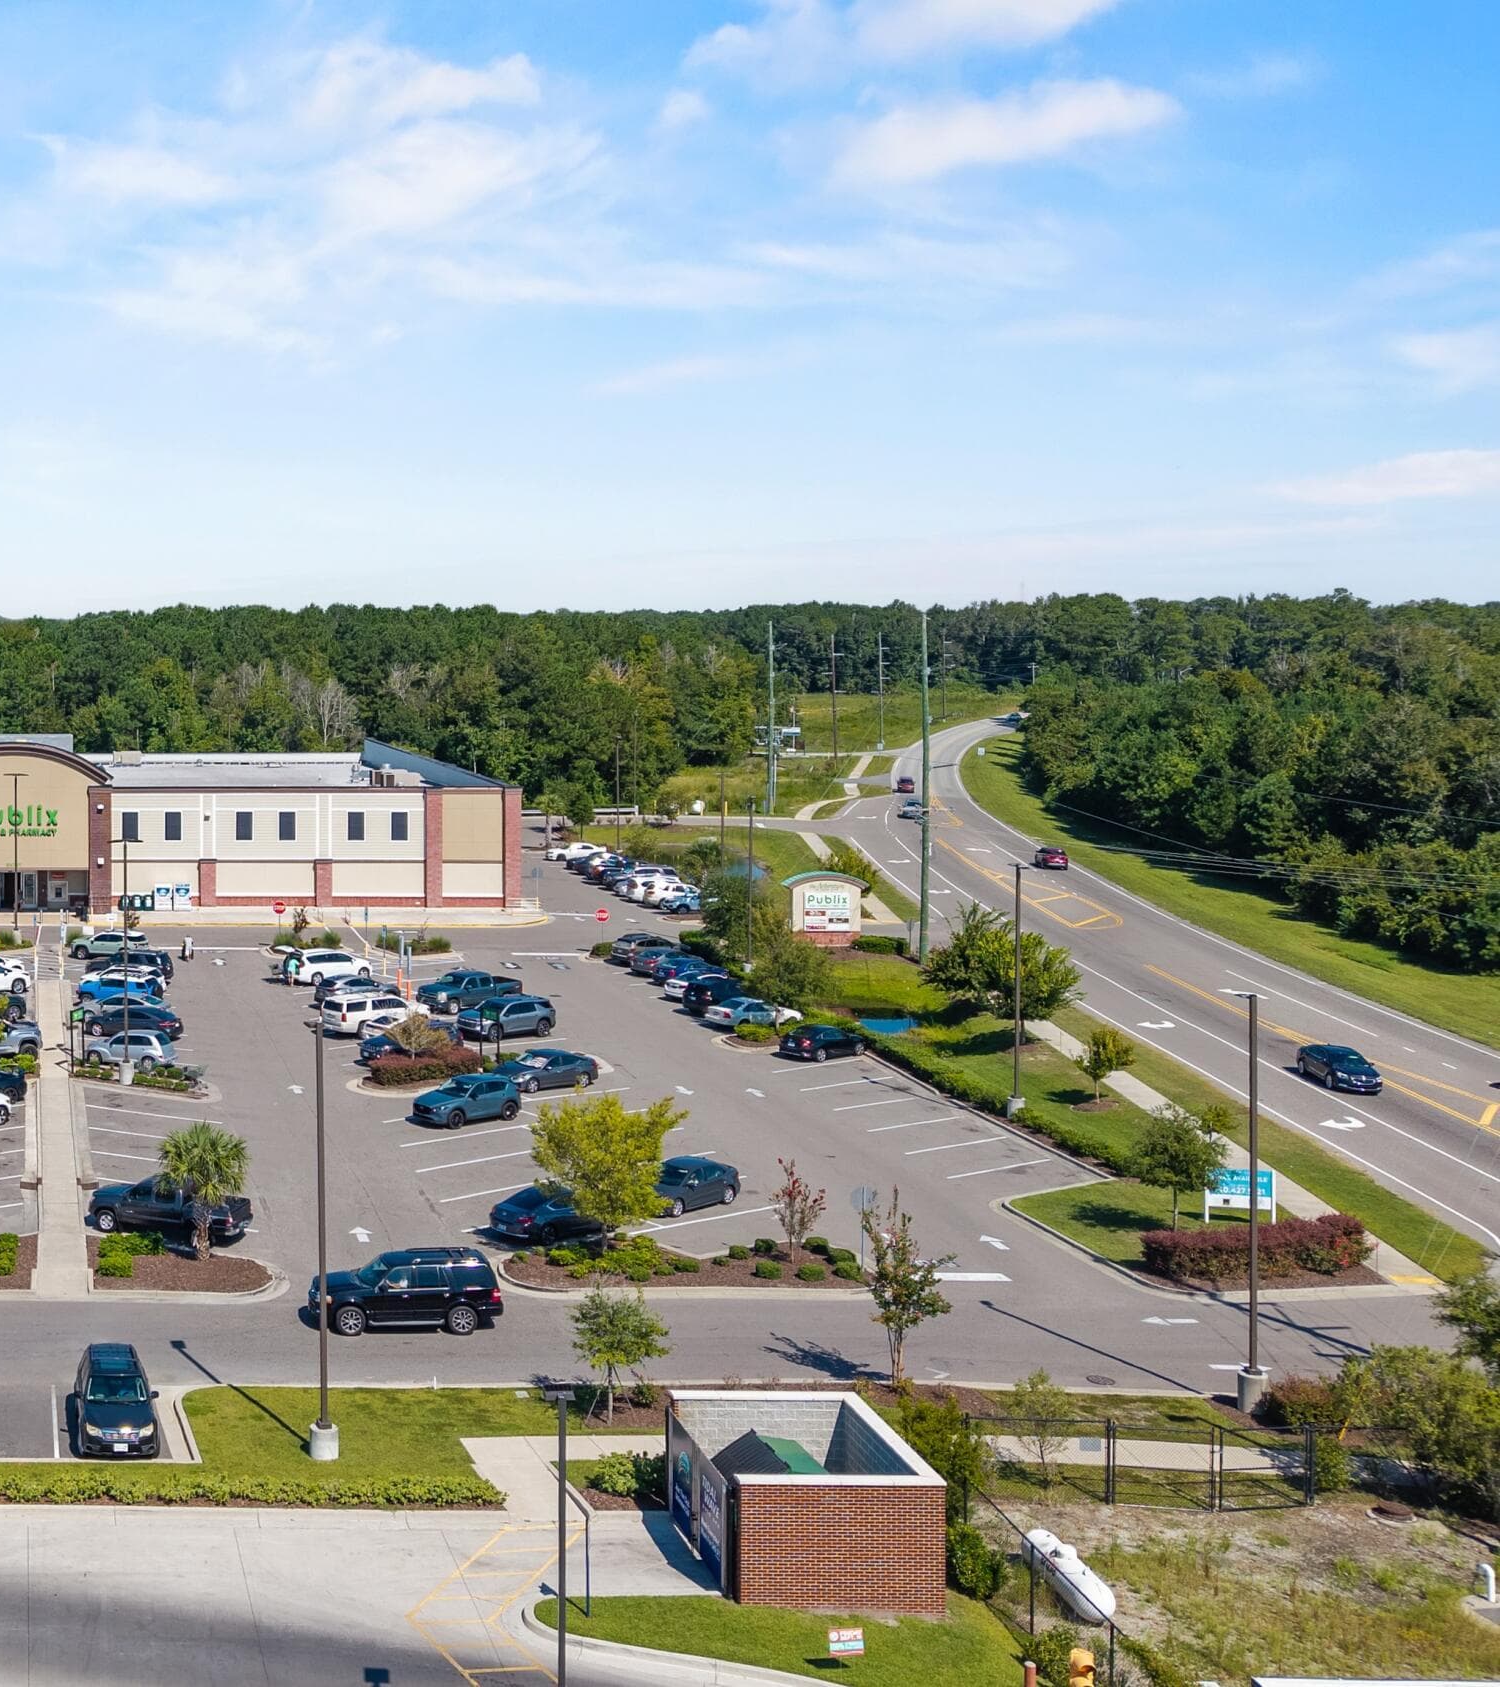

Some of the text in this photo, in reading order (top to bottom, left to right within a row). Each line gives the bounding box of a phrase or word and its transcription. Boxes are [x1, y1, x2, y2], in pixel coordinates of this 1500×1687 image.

[0, 828, 6, 837] &
[9, 828, 57, 837] PHARMACY
[807, 895, 848, 904] Publix
